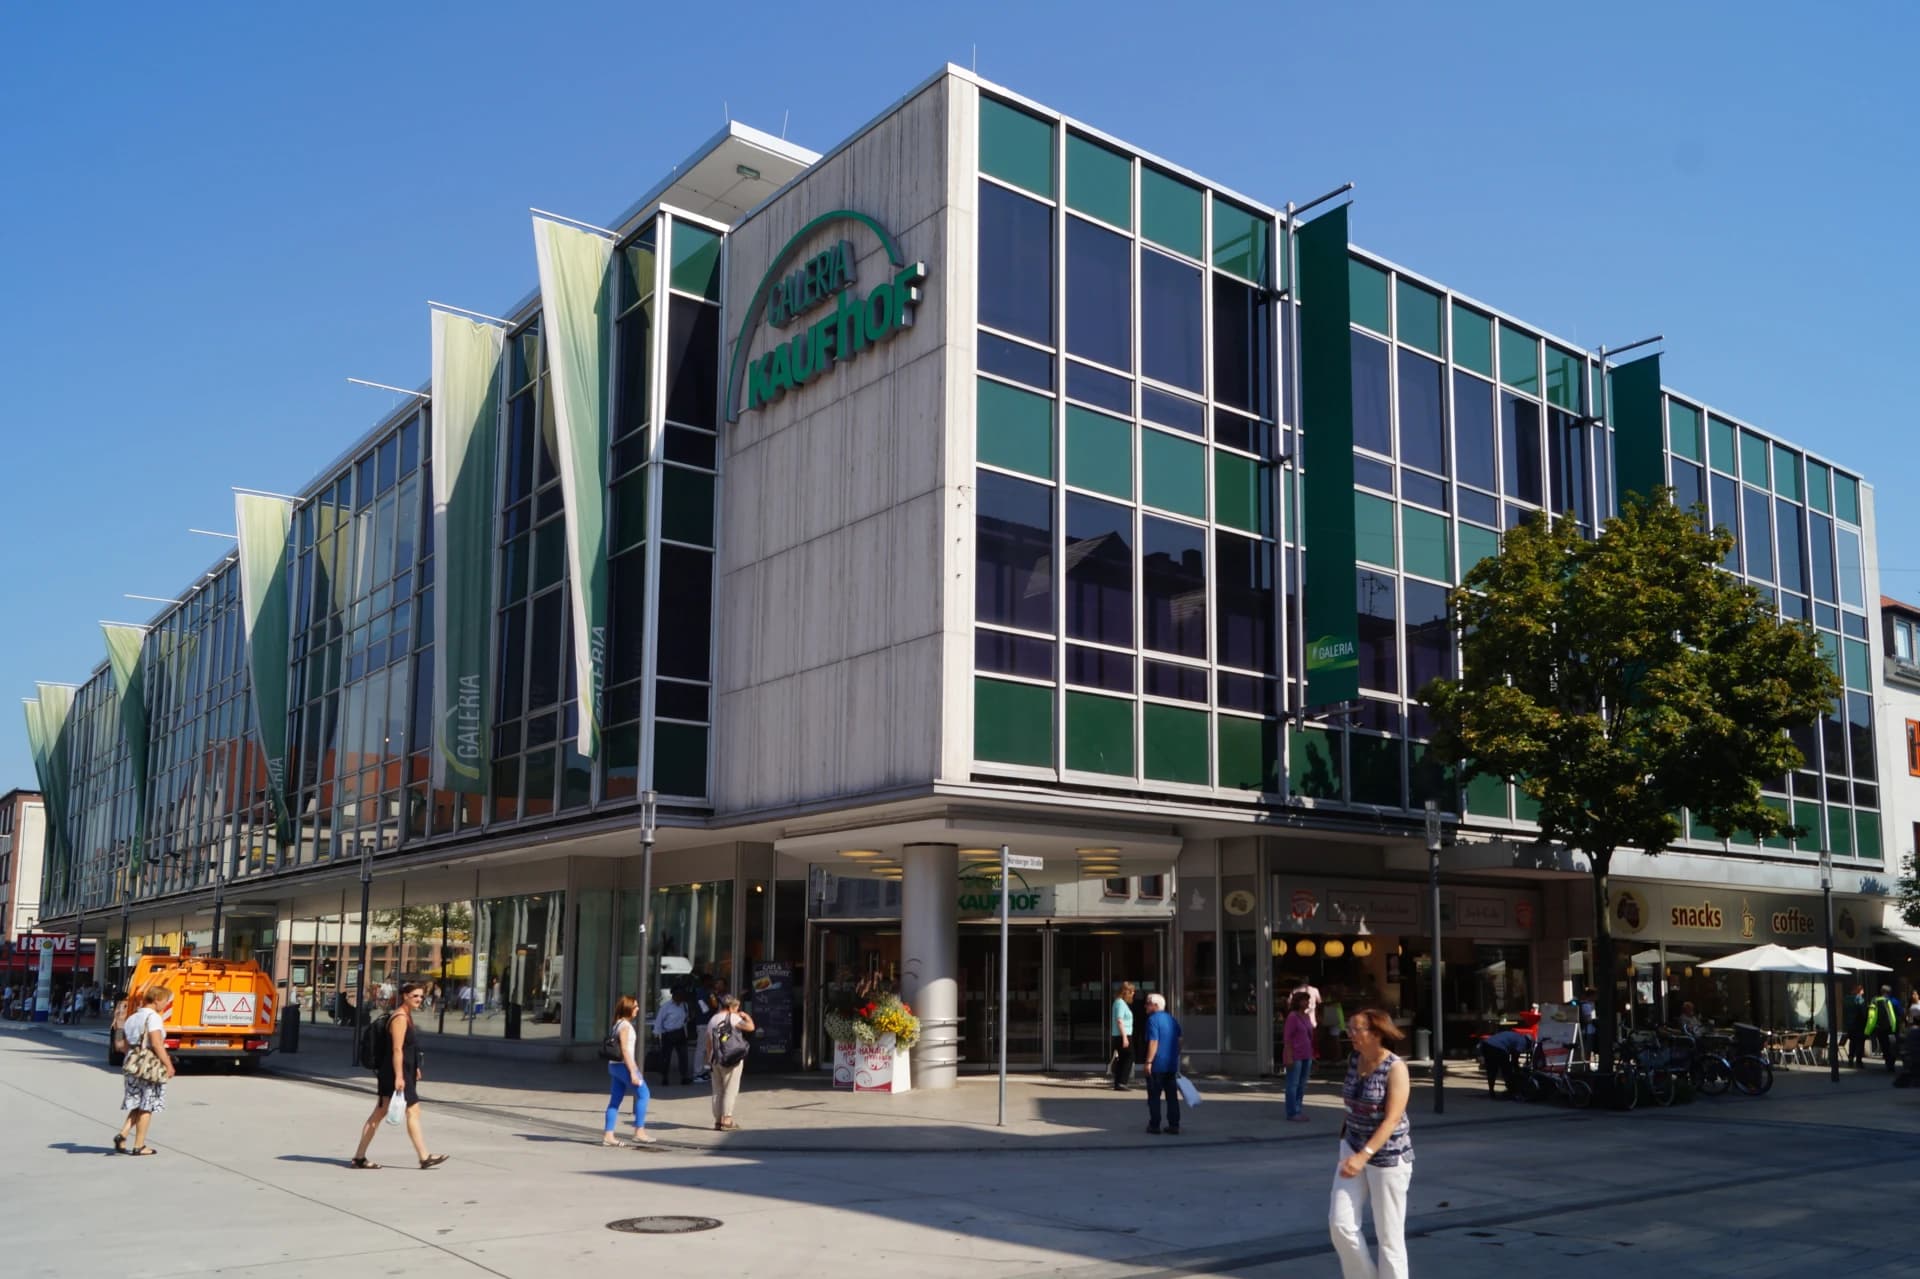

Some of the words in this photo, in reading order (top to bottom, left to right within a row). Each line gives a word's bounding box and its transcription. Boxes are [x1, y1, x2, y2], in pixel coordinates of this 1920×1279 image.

[767, 239, 857, 329] GALERIA
[1318, 641, 1354, 660] GALERIA
[457, 674, 480, 759] GALERIA
[1671, 902, 1723, 928] snacks
[1772, 908, 1815, 933] coffee
